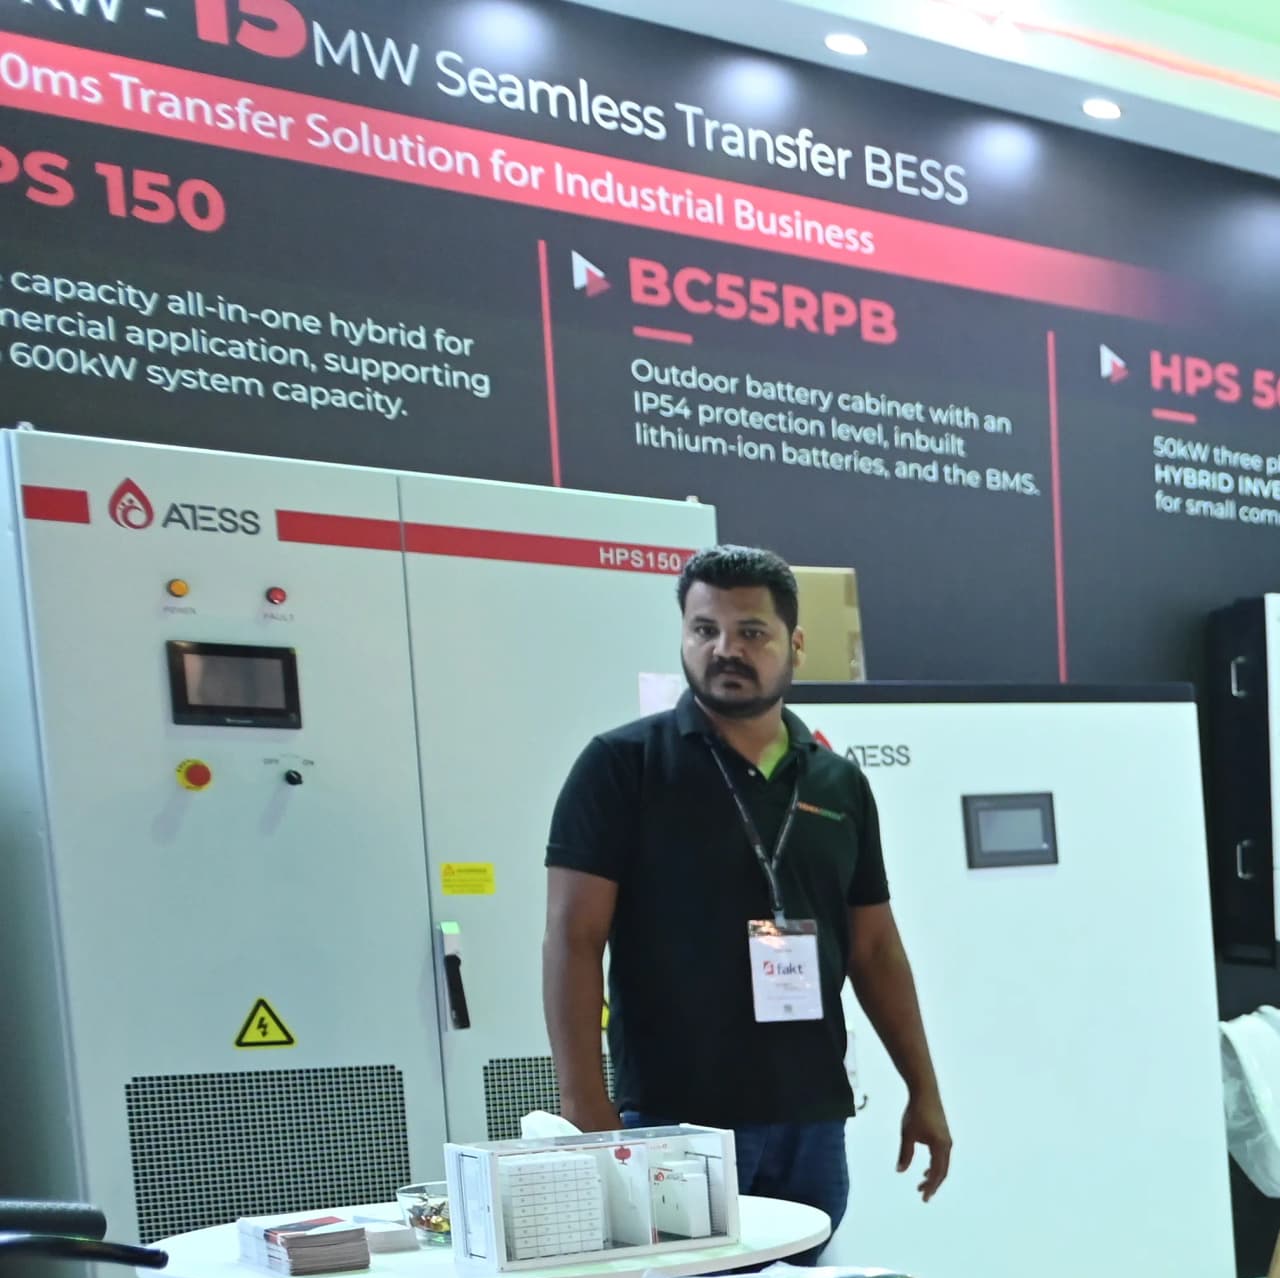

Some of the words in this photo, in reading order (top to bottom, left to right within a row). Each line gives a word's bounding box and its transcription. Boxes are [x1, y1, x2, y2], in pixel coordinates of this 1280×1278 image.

[435, 49, 668, 142] Seamless
[675, 101, 853, 181] Transfer
[864, 144, 969, 206] BESS
[94, 161, 227, 233] 150
[109, 72, 296, 141] Transfer
[305, 113, 480, 179] Solution
[490, 149, 545, 190] for
[555, 162, 724, 226] Industrial
[735, 198, 876, 256] Business
[10, 271, 159, 316] capacity
[167, 290, 323, 335] all-in-one
[329, 311, 427, 350] hybrid
[433, 328, 475, 357] for
[628, 256, 898, 345] BC55RPB
[9, 342, 138, 381] 600kW
[146, 362, 265, 397] system
[272, 380, 409, 420] capacity.
[125, 324, 318, 374] application,
[324, 350, 491, 399] supporting
[631, 358, 740, 395] Outdoor
[745, 373, 834, 414] battery
[838, 391, 926, 423] cabinet
[929, 404, 980, 431] with
[983, 413, 1013, 435] an
[1150, 350, 1242, 404] HPS
[633, 390, 693, 420] IP54
[698, 403, 826, 439] protection
[831, 416, 890, 450] level,
[894, 425, 968, 458] inbuilt
[634, 421, 776, 463] lithium-ion
[781, 441, 891, 480] batteries,
[894, 459, 939, 483] and
[943, 462, 983, 489] the
[985, 467, 1041, 497] BMS.
[1153, 434, 1211, 464] 50kW
[1213, 445, 1264, 472] three
[1154, 463, 1235, 495] HYBRID
[1155, 489, 1183, 514] for
[1185, 497, 1237, 521] small
[161, 503, 262, 537] ATESS
[599, 546, 681, 571] HPS150
[845, 745, 912, 768] ATESS
